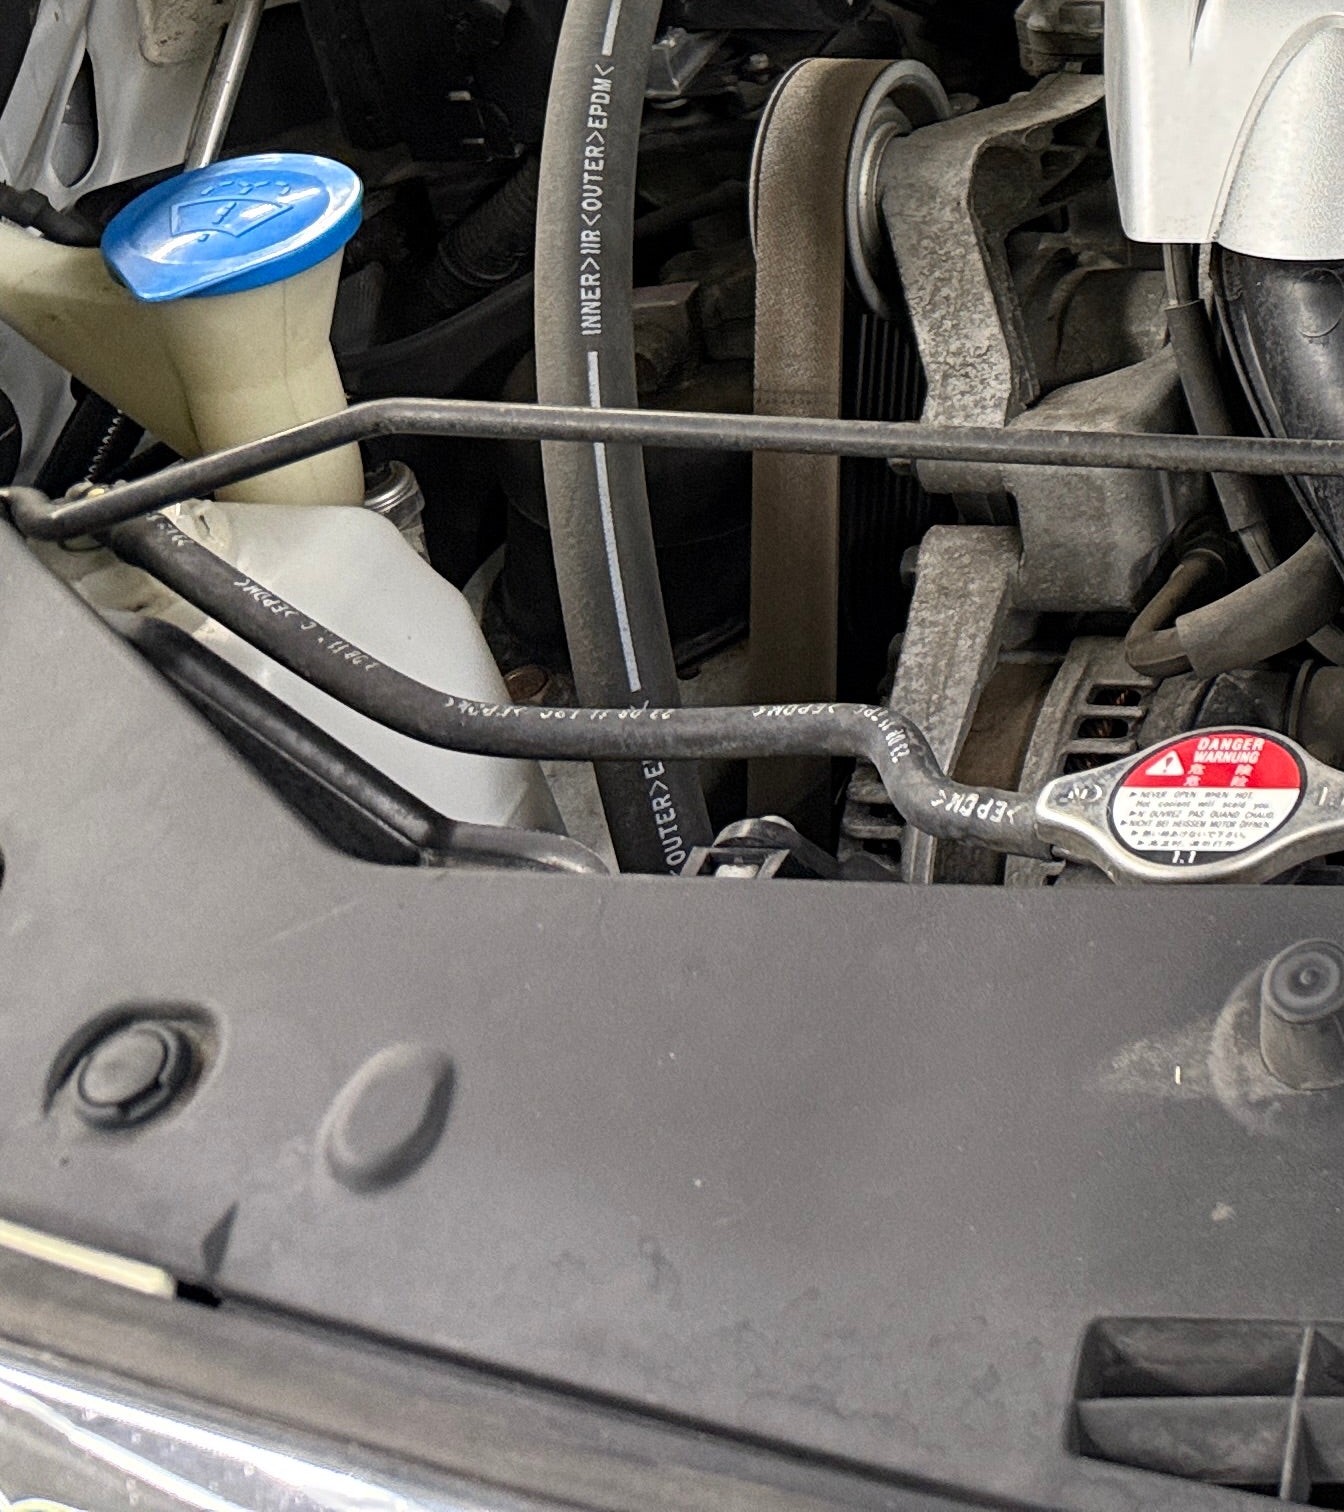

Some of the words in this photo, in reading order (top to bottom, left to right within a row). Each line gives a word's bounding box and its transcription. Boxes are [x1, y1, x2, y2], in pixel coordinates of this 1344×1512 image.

[1197, 738, 1265, 751] DANGER
[1193, 750, 1260, 764] WARNUNG
[1172, 850, 1196, 864] 1.1
